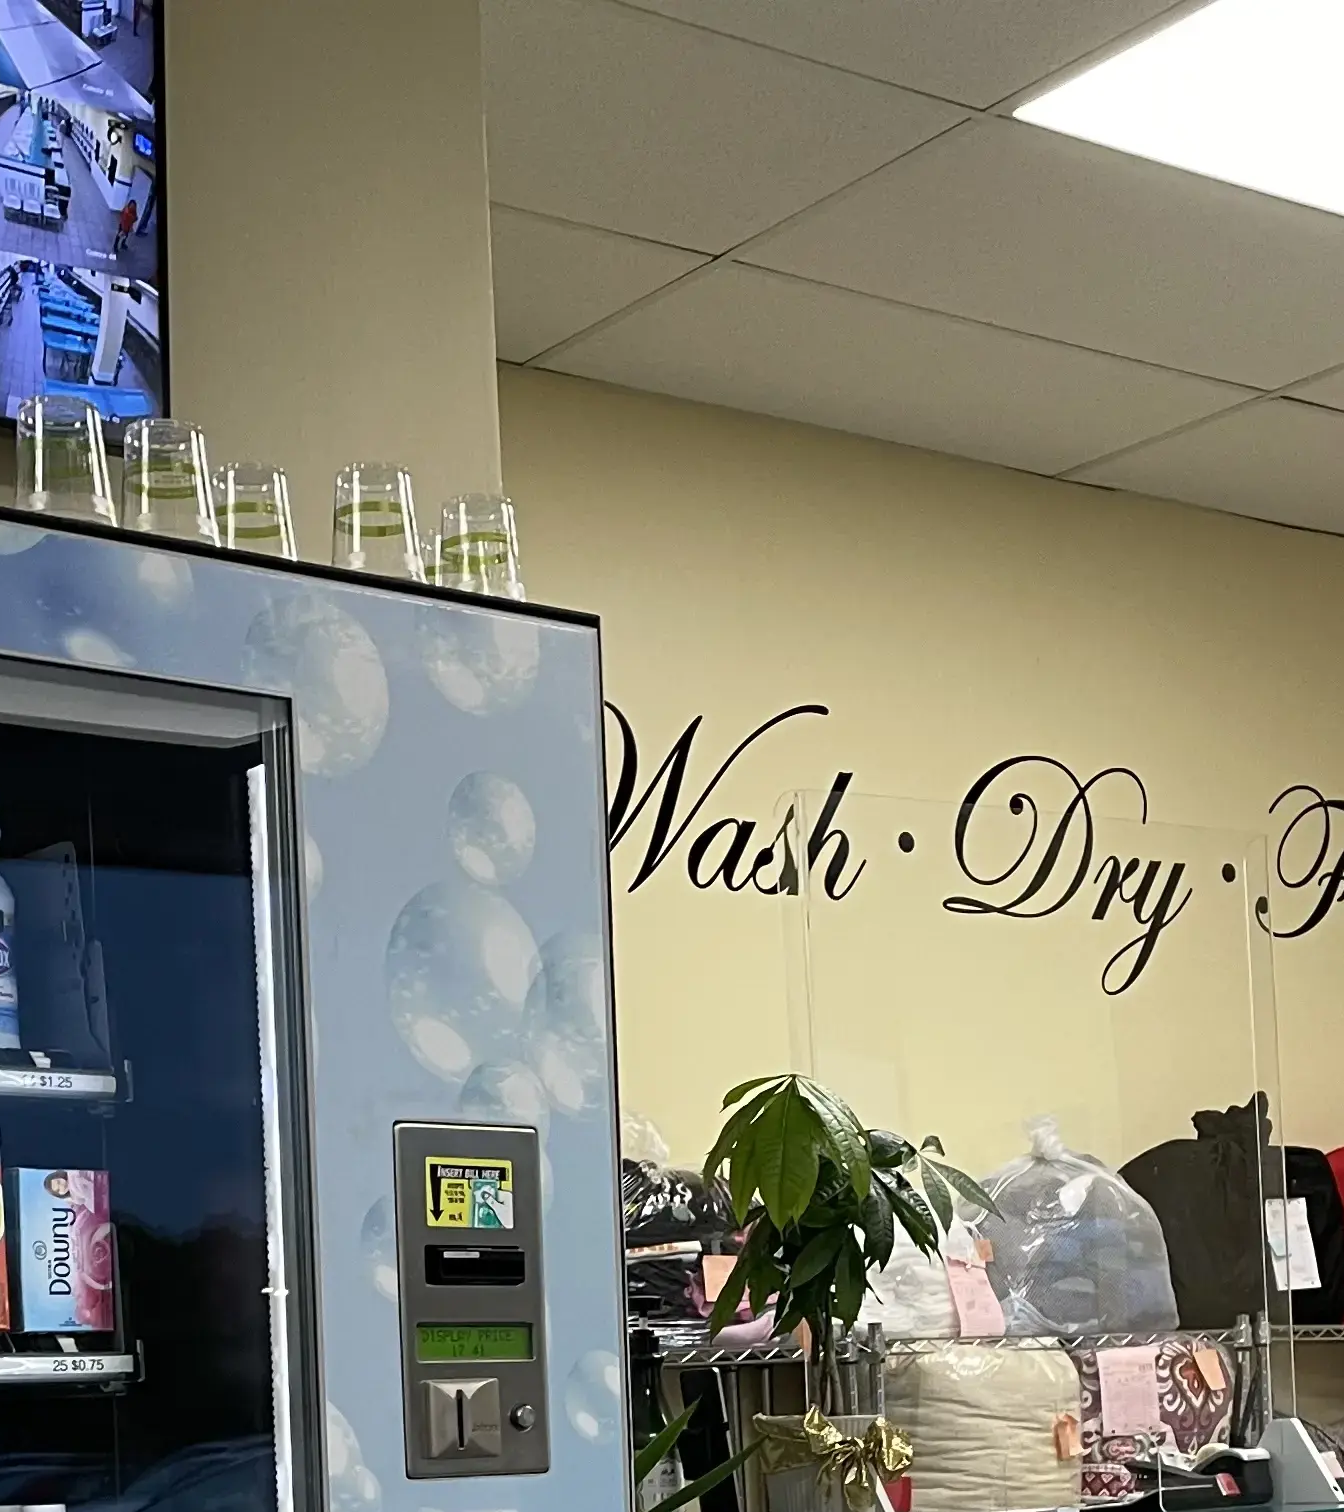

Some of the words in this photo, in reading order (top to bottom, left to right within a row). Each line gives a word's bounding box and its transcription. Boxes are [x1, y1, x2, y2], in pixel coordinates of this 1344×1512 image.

[605, 700, 868, 901] Wash
[942, 755, 1193, 996] Dry
[39, 1075, 73, 1088] $1.25
[437, 1165, 463, 1178] INSERT
[48, 1207, 77, 1296] Downy
[52, 1360, 69, 1372] 25
[71, 1359, 105, 1372] $0.75
